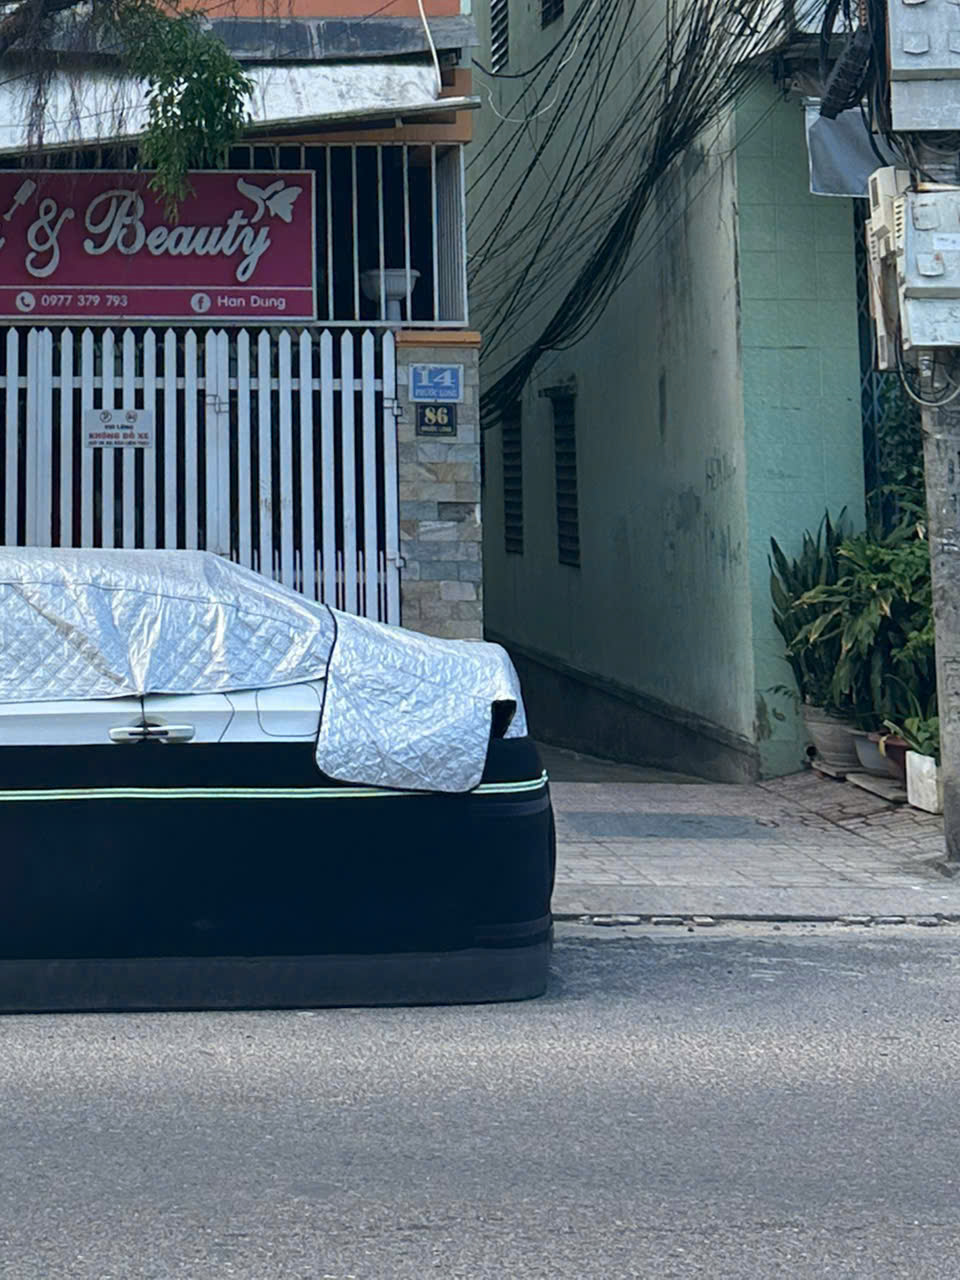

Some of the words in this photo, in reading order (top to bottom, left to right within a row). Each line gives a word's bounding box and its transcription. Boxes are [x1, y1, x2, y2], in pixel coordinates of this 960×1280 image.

[25, 198, 75, 277] &
[83, 188, 271, 282] Beauty
[41, 295, 72, 307] 0977
[76, 295, 101, 307] 379
[105, 295, 129, 307] 793
[217, 296, 246, 308] Han
[250, 296, 287, 310] Dung
[416, 366, 456, 386] 14
[424, 407, 448, 425] 86
